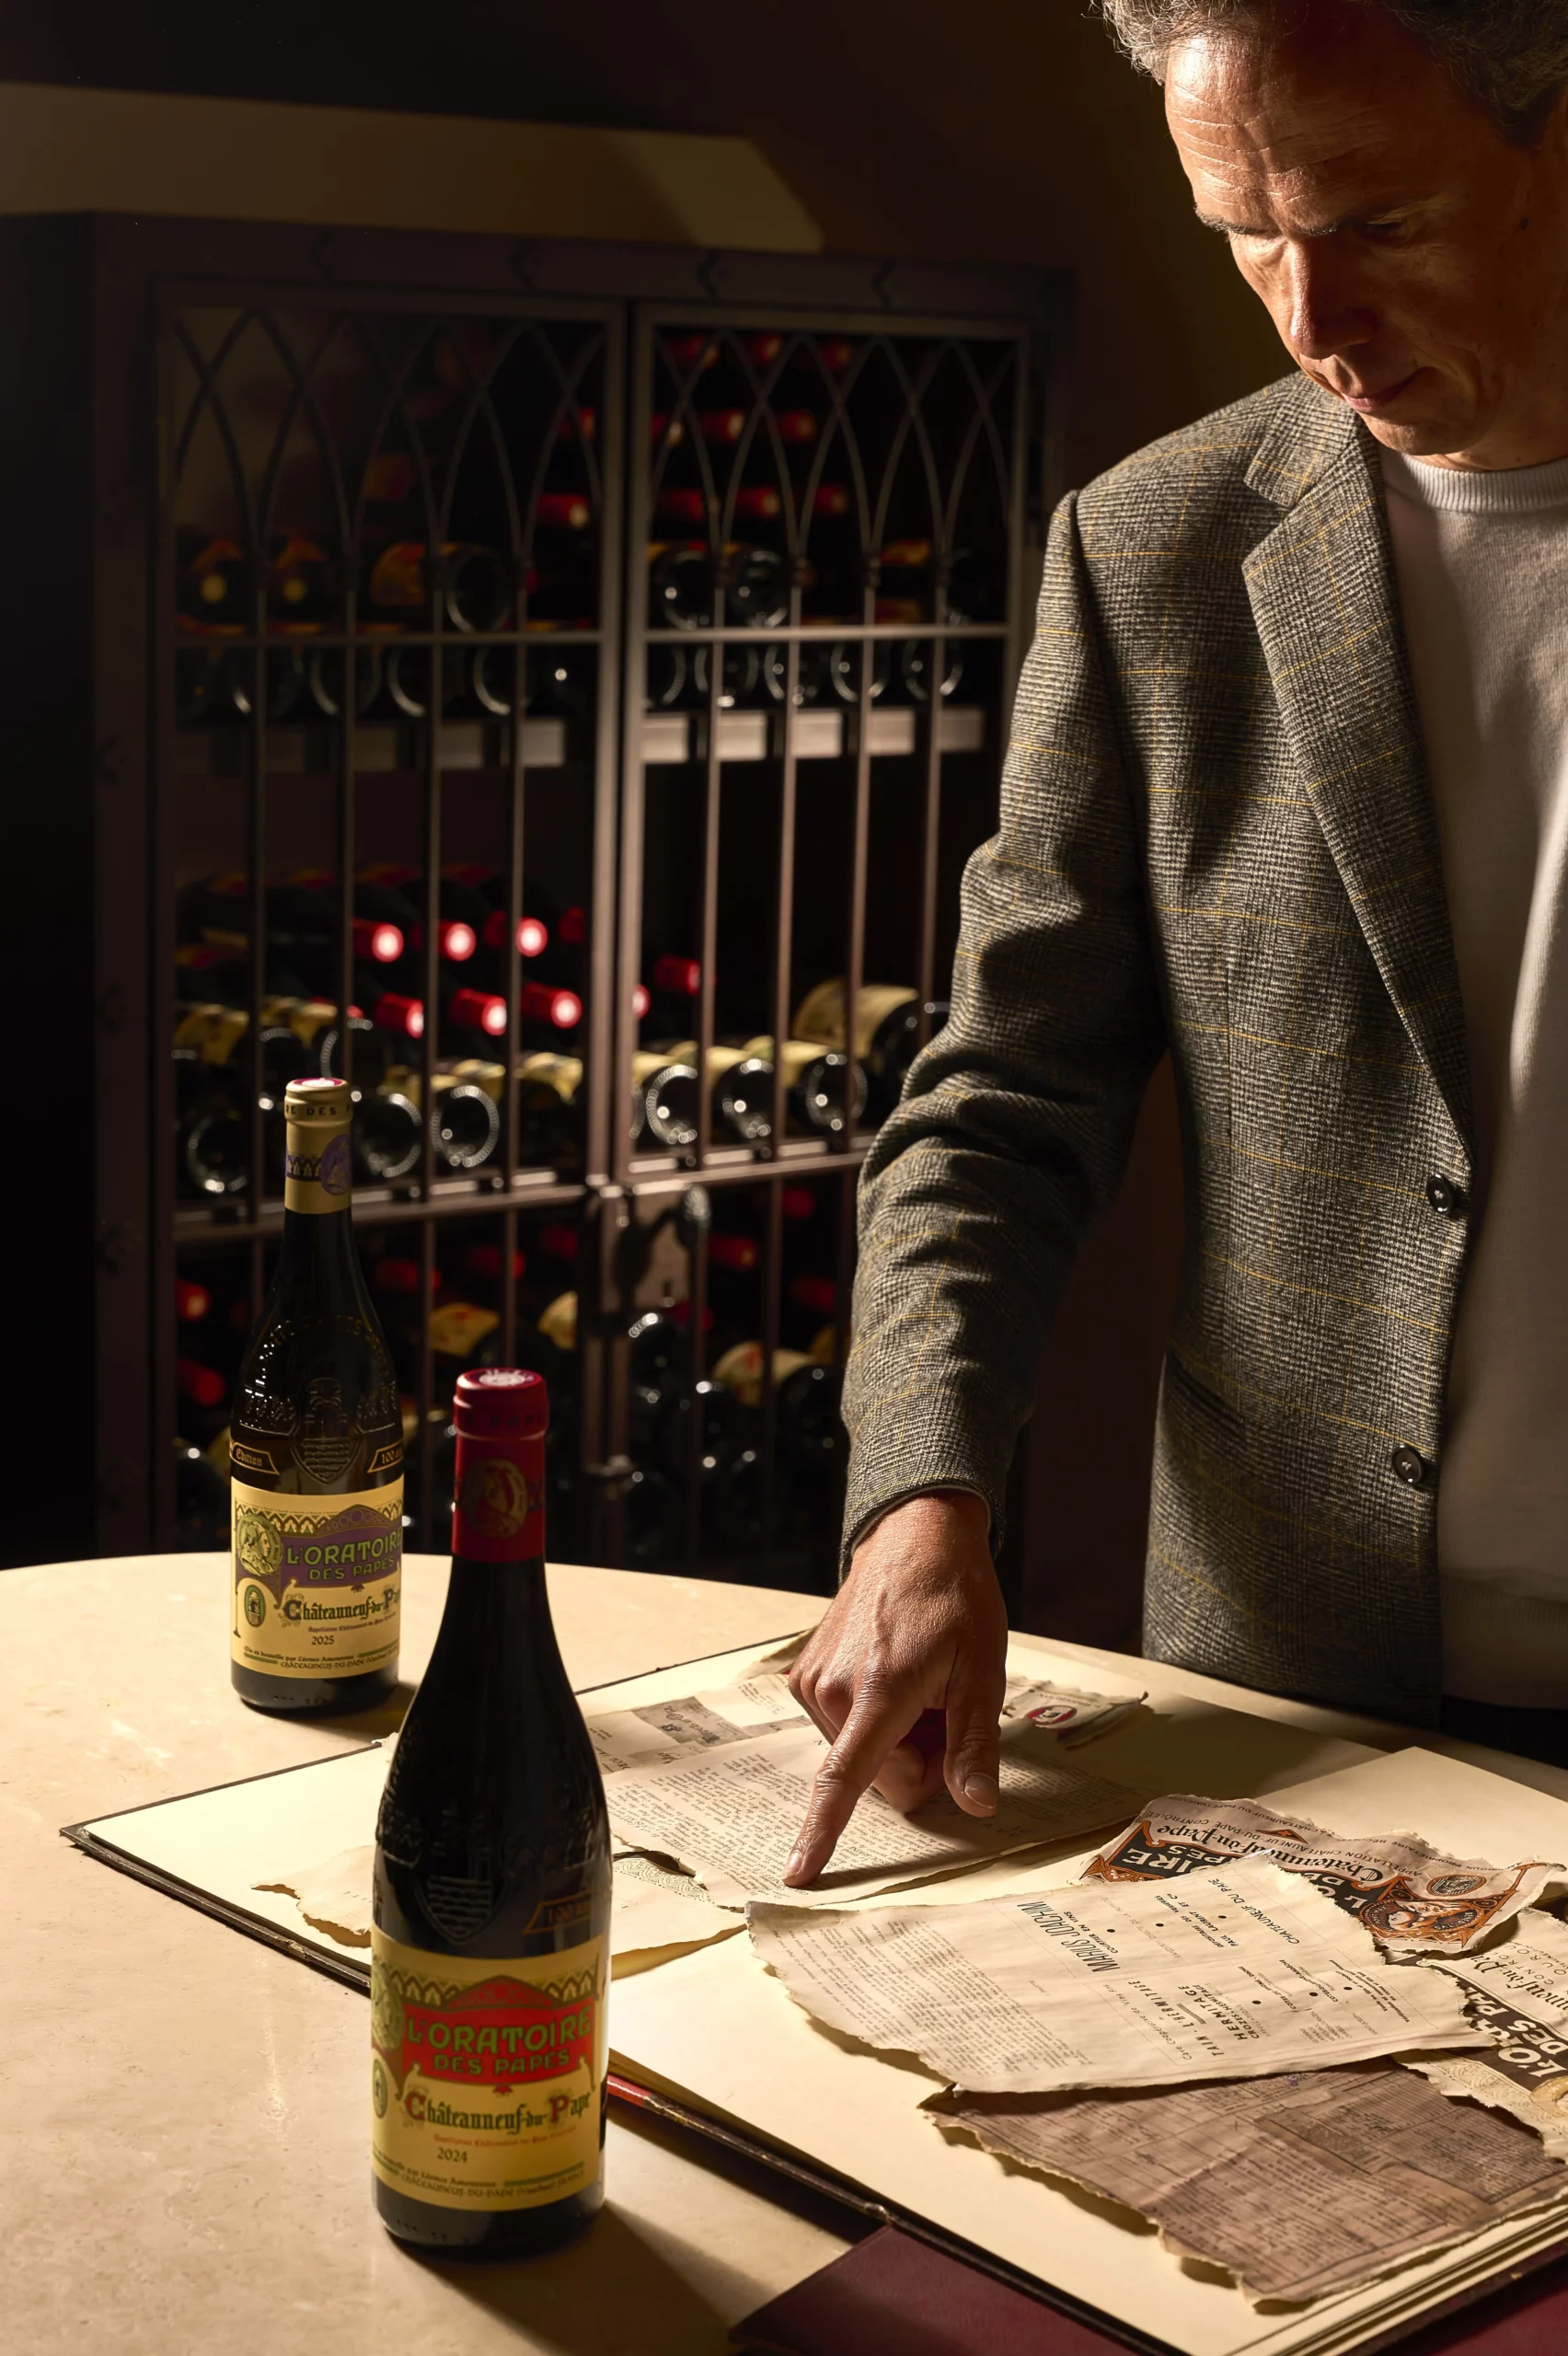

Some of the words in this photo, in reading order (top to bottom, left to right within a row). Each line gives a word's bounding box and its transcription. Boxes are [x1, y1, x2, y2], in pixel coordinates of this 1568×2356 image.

[306, 1106, 338, 1116] DES
[309, 1567, 345, 1581] DES
[352, 1555, 395, 1577] PAPES
[311, 1635, 335, 1646] 2025
[1345, 1852, 1422, 1877] APPELLATION
[1208, 1878, 1232, 1893] PAPE
[1228, 1893, 1246, 1903] DU
[1017, 1900, 1080, 1936] JOACHIM
[1063, 1911, 1079, 1923] VINS
[1078, 1923, 1090, 1932] EN
[1189, 1911, 1219, 1932] LAURENT
[1241, 1905, 1300, 1945] CHATEAUNEUF
[1089, 1933, 1119, 1954] COURTIER
[1220, 1934, 1239, 1947] PAUL
[1061, 1938, 1121, 1972] MARIUS
[1505, 1945, 1567, 1976] OUROU
[1493, 1952, 1554, 1985] CONTROL
[1115, 1993, 1130, 2006] Vins
[1128, 1980, 1194, 2027] L'HERMITAGE
[1178, 1985, 1248, 2040] HERMITAGE
[408, 2006, 592, 2054] L'ORATOIRE
[1506, 2019, 1568, 2055] DES
[1176, 2046, 1193, 2061] Cave
[1195, 2035, 1225, 2057] TAIN
[433, 2053, 482, 2075] DES
[494, 2049, 570, 2075] PAPES
[437, 2147, 468, 2164] 2024
